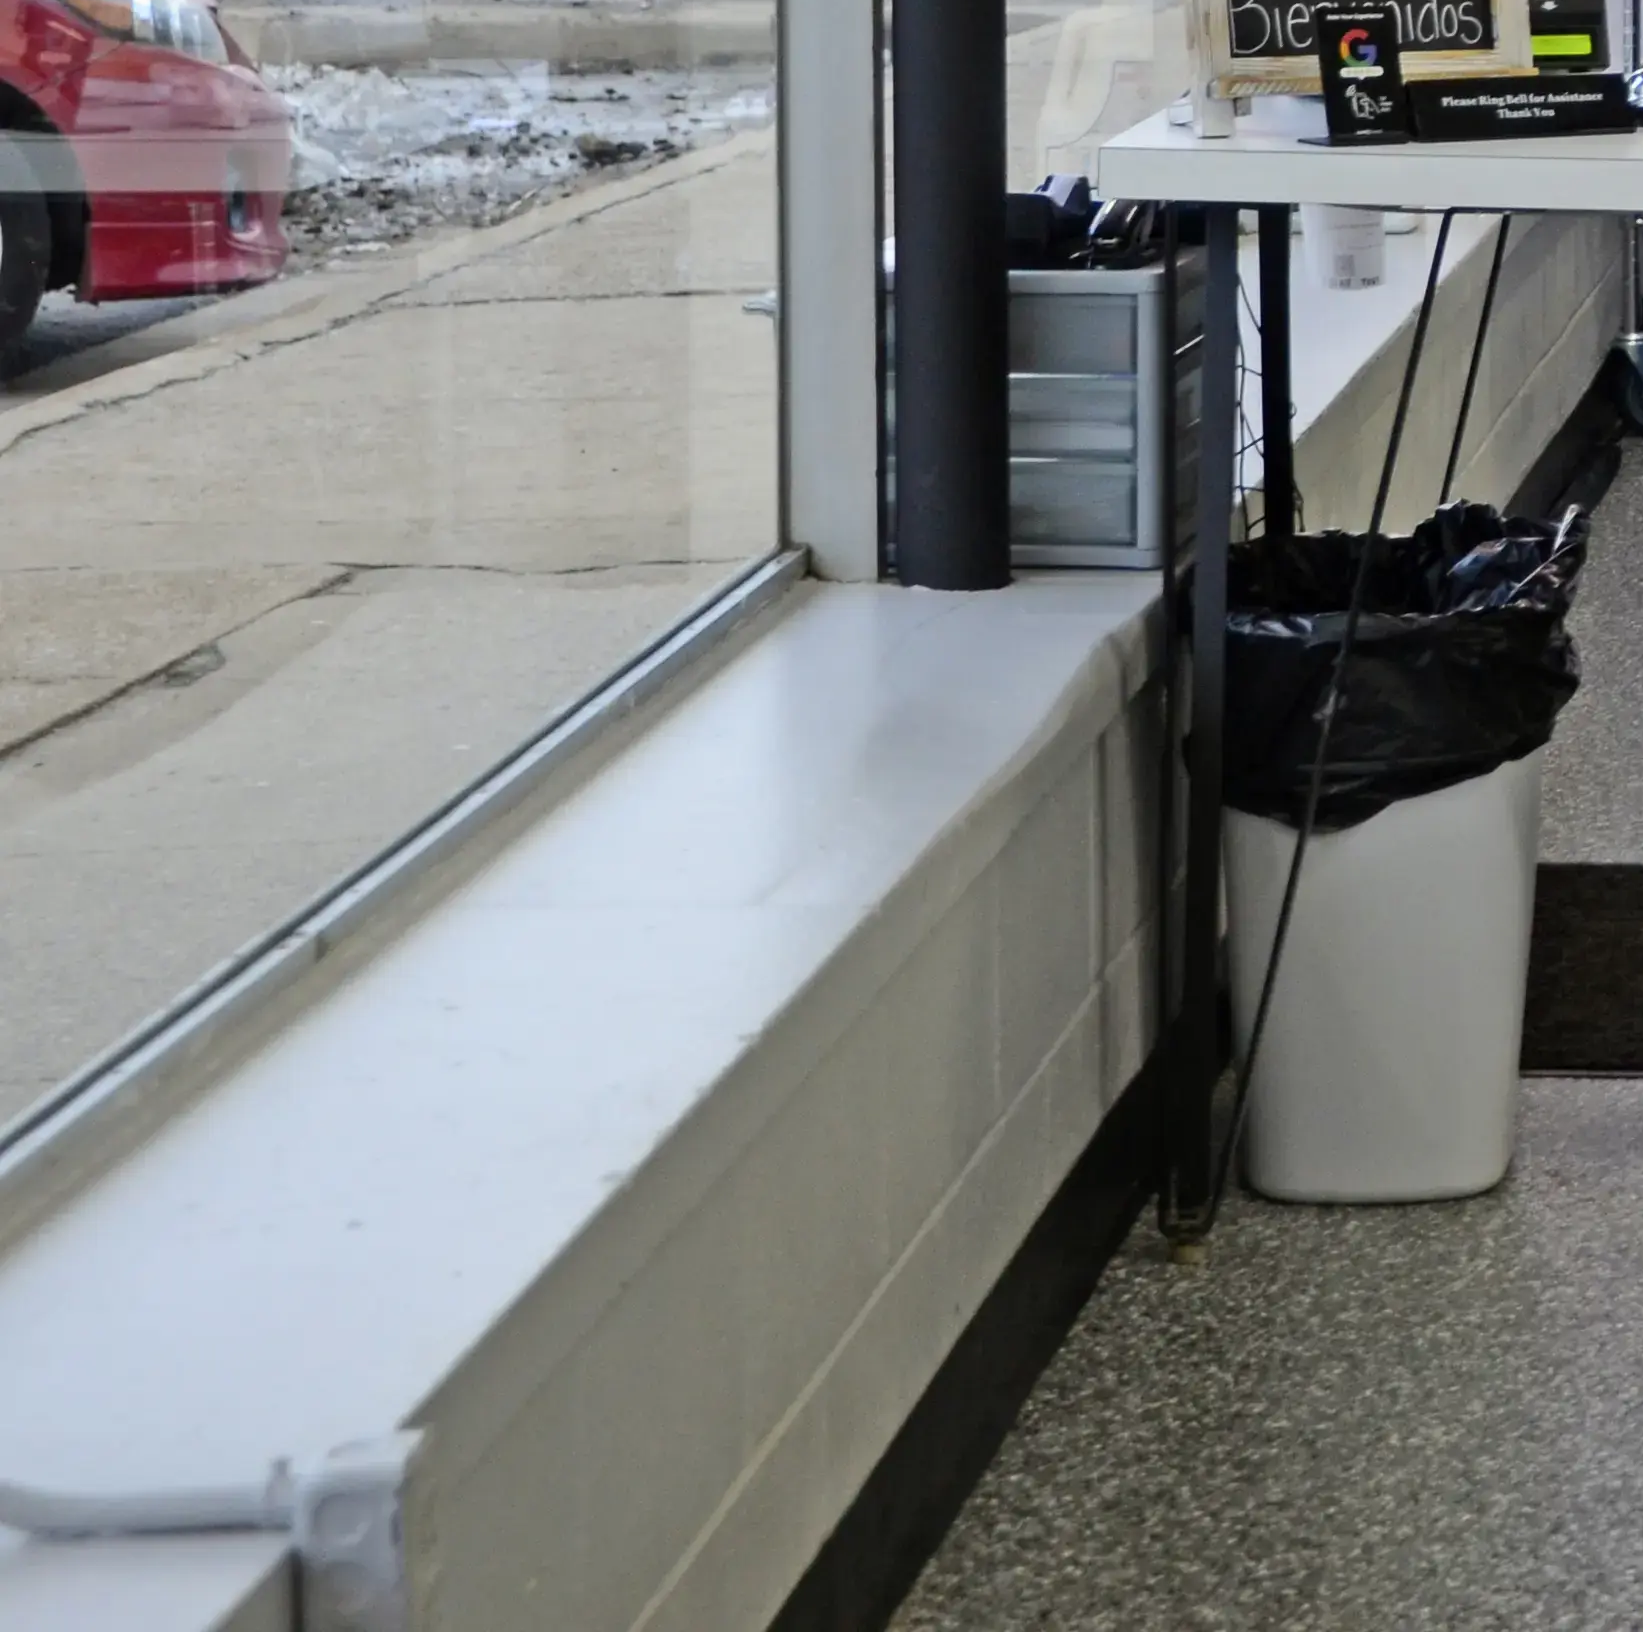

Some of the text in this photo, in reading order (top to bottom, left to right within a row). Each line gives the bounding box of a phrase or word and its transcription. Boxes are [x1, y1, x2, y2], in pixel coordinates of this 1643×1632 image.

[1440, 90, 1604, 108] Please Ring Bell for Assistance
[1496, 106, 1556, 119] Thank You
